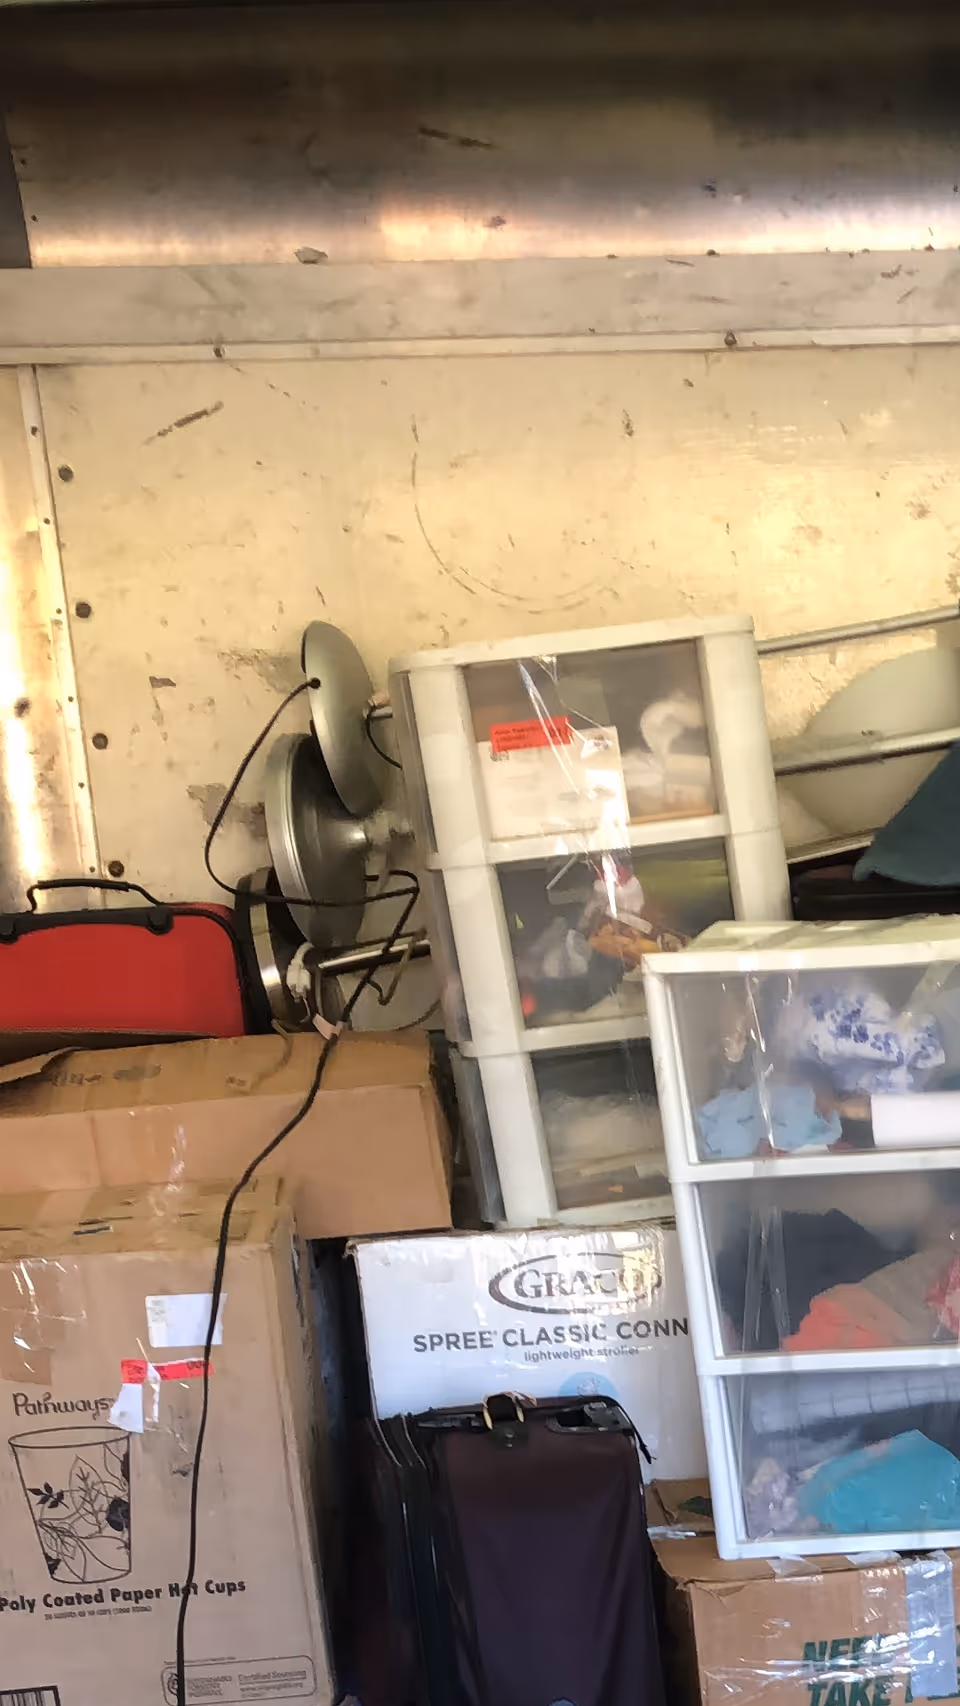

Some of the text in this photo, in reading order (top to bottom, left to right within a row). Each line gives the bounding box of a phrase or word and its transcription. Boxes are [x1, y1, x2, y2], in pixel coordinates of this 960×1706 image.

[514, 1268, 645, 1298] GRACO
[413, 1317, 690, 1353] SPREE CLASSIC CONN
[524, 1346, 594, 1364] lightweight
[12, 1391, 109, 1420] Pathways
[0, 1595, 36, 1614] Poly
[43, 1588, 105, 1608] Coated
[110, 1586, 162, 1605] Paper
[205, 1579, 246, 1597] Cups
